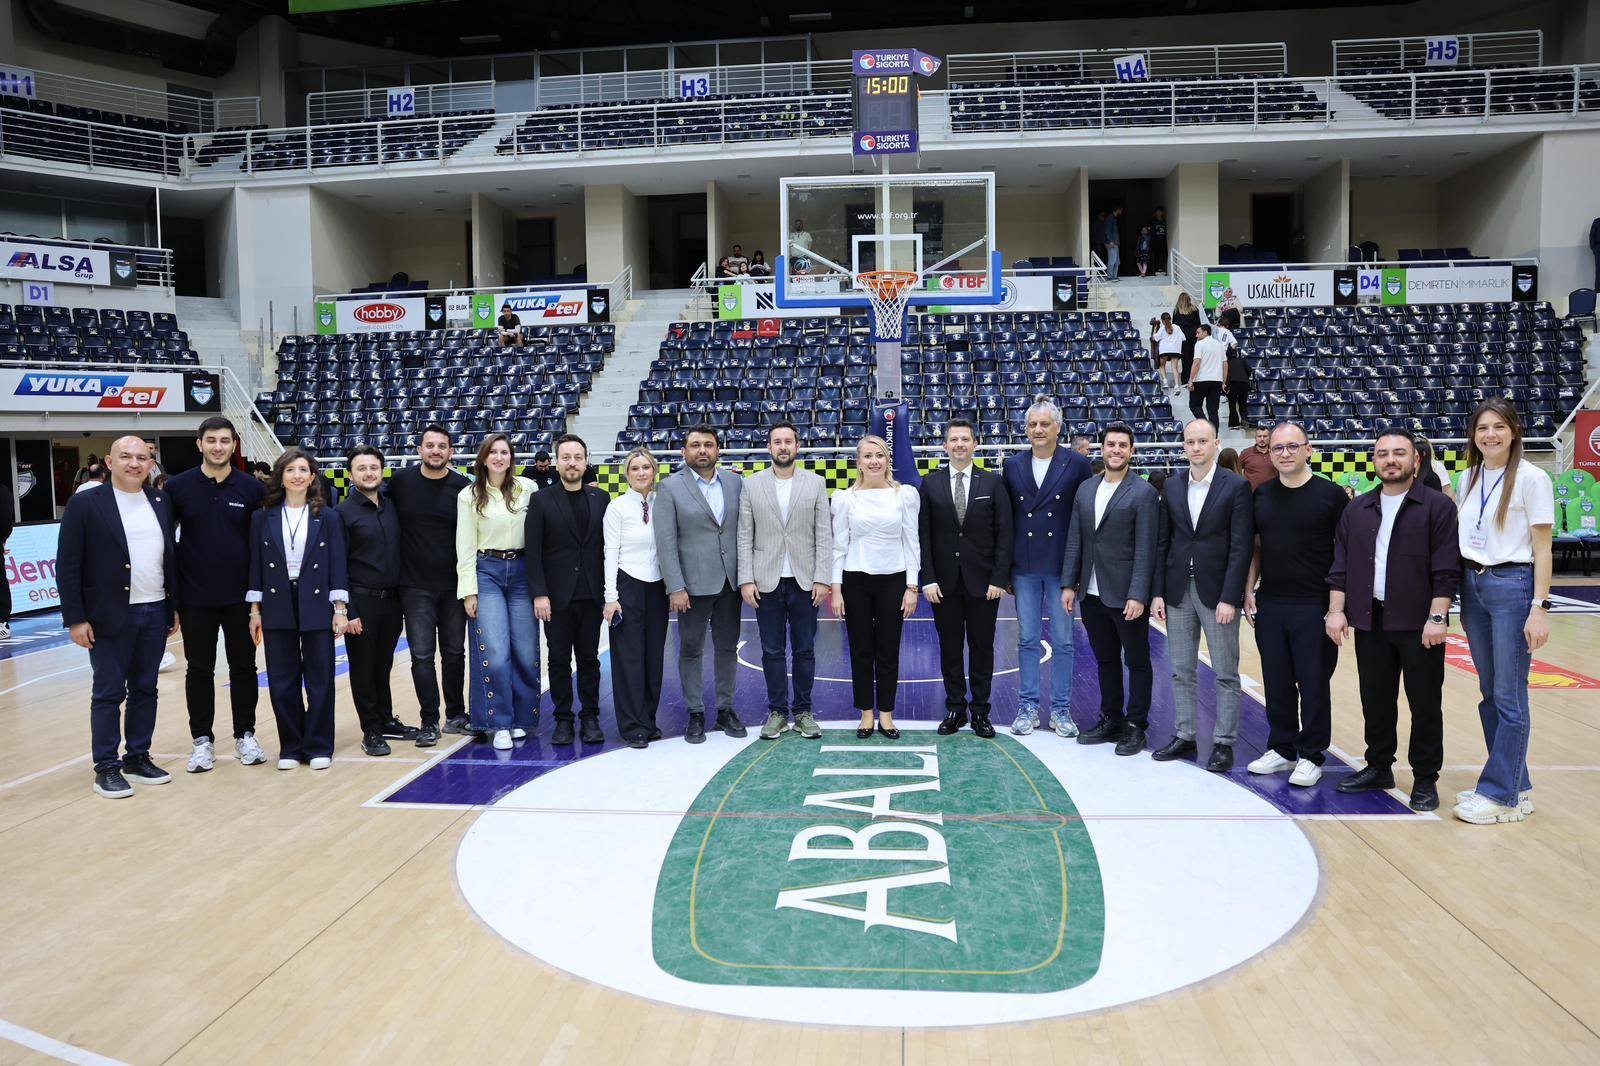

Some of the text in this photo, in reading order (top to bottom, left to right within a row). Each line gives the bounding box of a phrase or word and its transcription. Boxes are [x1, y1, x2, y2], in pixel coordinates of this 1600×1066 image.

[1428, 40, 1457, 60] H5
[1117, 59, 1145, 80] H4
[0, 72, 32, 95] H1
[682, 78, 708, 97] H3
[867, 76, 908, 95] 15:00
[389, 94, 413, 112] H2
[6, 251, 94, 273] ALSA
[74, 272, 94, 280] Grup
[957, 275, 986, 288] TBF
[1360, 275, 1380, 290] D4
[29, 285, 48, 300] D1
[510, 298, 546, 309] YUKA
[556, 303, 578, 315] tel
[361, 306, 399, 322] hobby
[28, 377, 102, 393] YUKA
[121, 390, 158, 405] tel
[775, 744, 958, 944] ABALI
